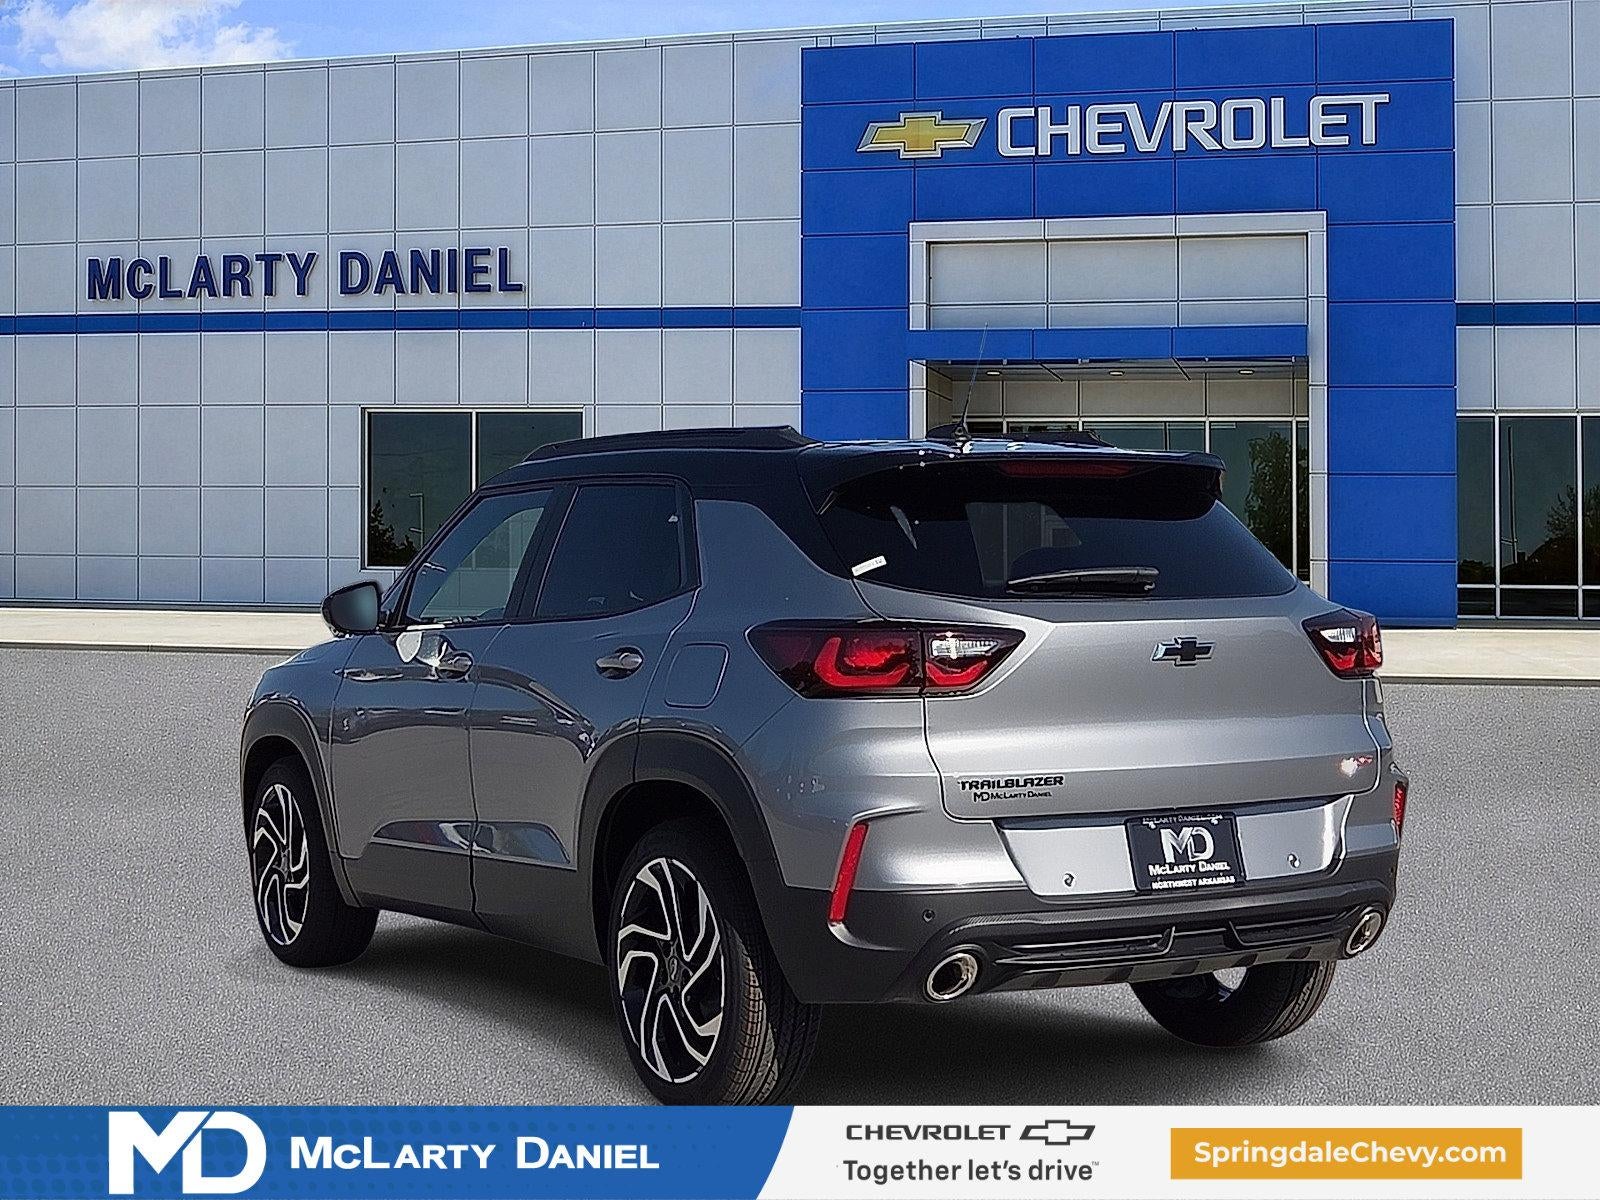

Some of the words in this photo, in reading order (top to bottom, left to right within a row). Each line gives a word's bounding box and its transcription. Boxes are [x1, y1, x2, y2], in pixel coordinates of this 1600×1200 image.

[997, 94, 1390, 157] CHEVROLET
[338, 246, 525, 295] DANIEL
[958, 775, 1064, 791] TRAILBLAZER
[1160, 826, 1215, 863] MD
